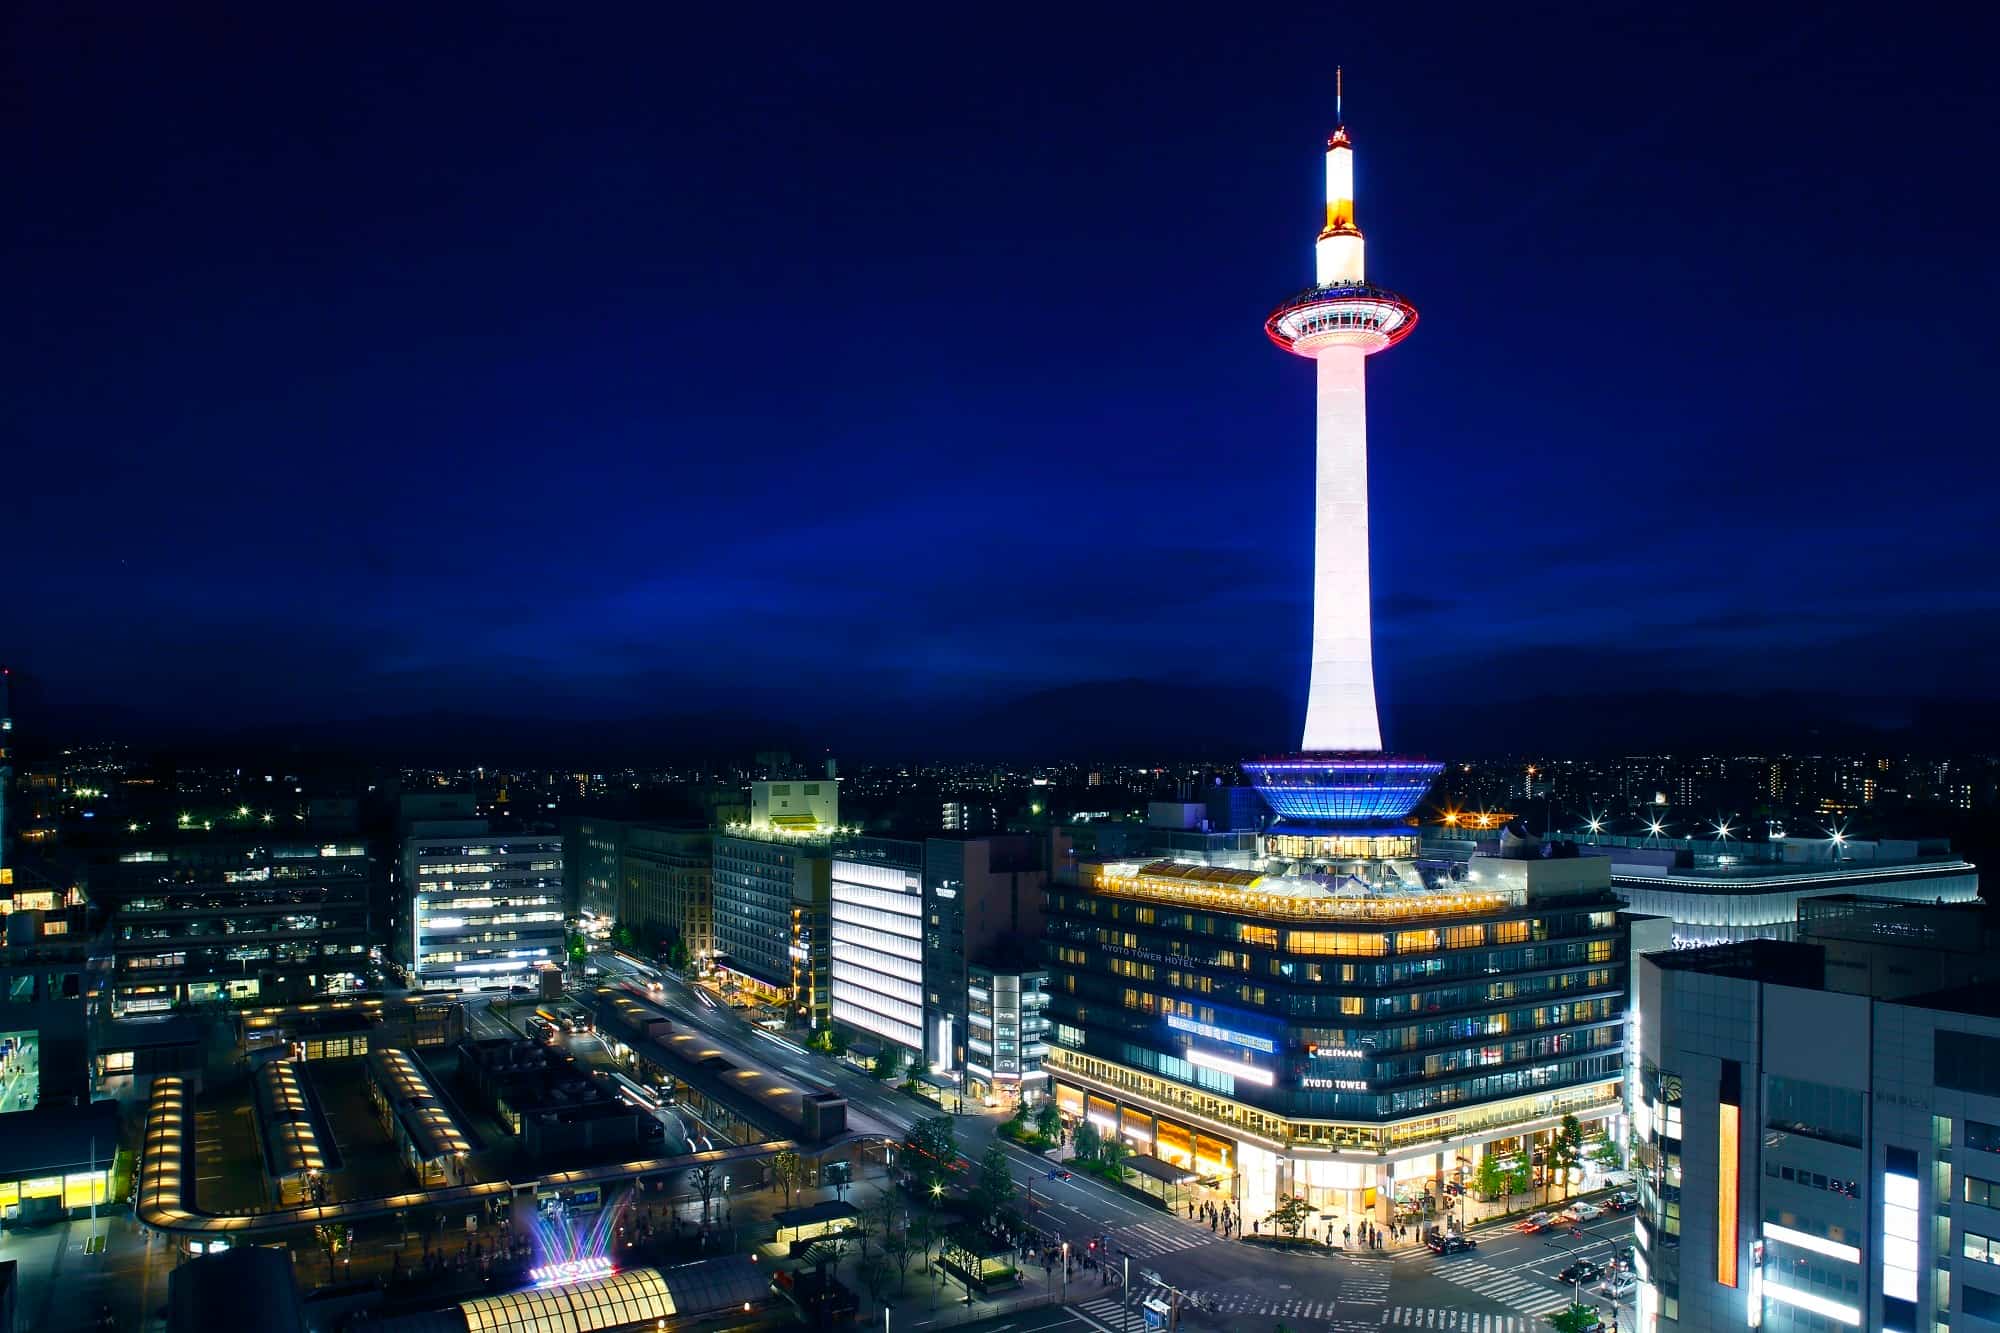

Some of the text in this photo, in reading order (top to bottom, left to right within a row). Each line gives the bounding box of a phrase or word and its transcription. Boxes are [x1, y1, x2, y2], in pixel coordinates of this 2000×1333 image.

[1102, 943, 1194, 968] KYOTO TOWER HOTEL
[1317, 1048, 1363, 1058] KEIHAN
[1303, 1078, 1367, 1090] KYOTO TOWER
